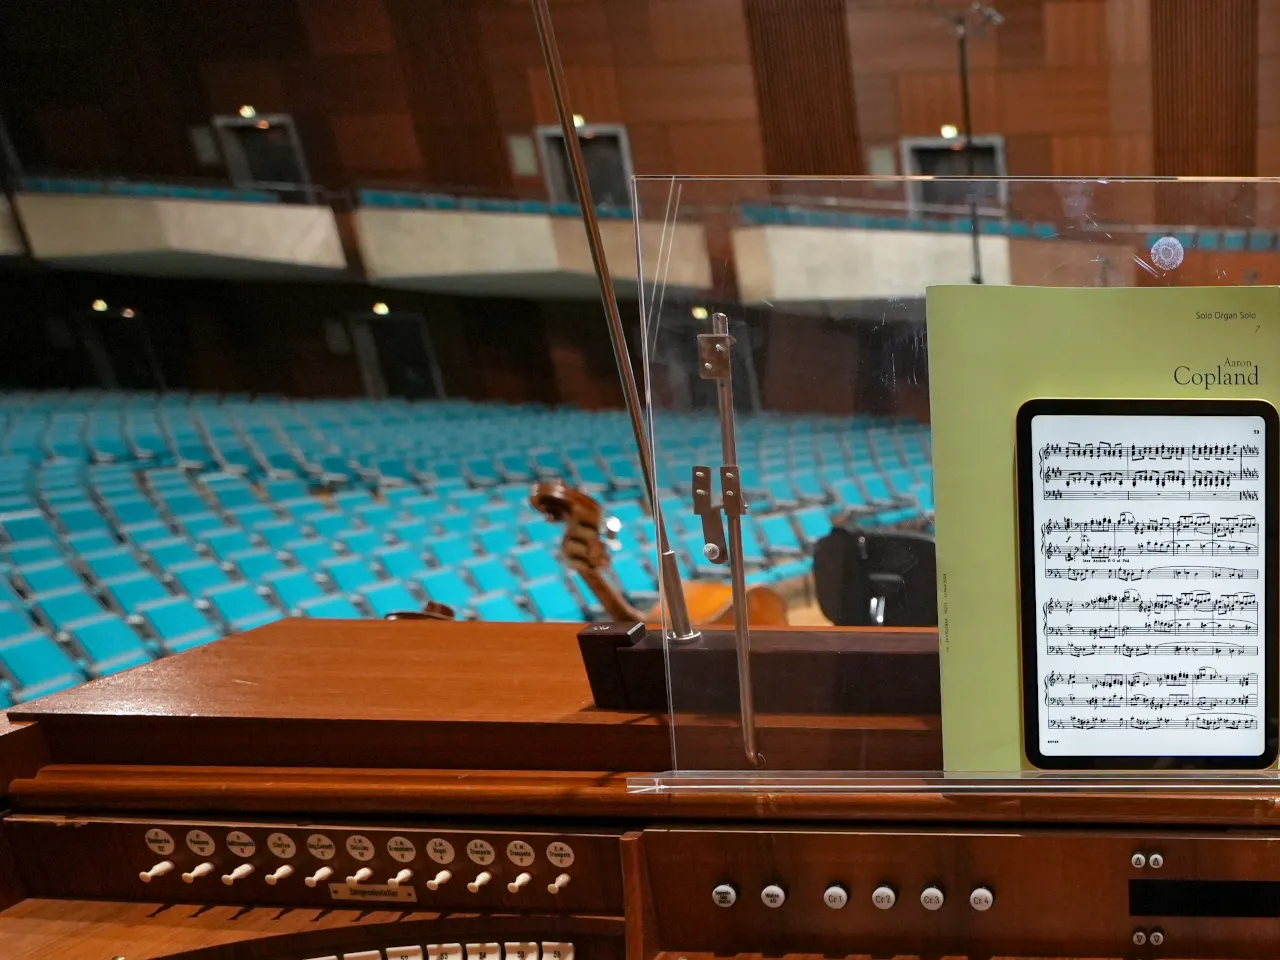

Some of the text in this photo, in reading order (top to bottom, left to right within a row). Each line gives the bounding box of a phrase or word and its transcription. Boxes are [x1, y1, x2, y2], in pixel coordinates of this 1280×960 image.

[1214, 312, 1237, 321] Organ
[1224, 358, 1252, 367] Aaron
[1174, 365, 1259, 390] Copland
